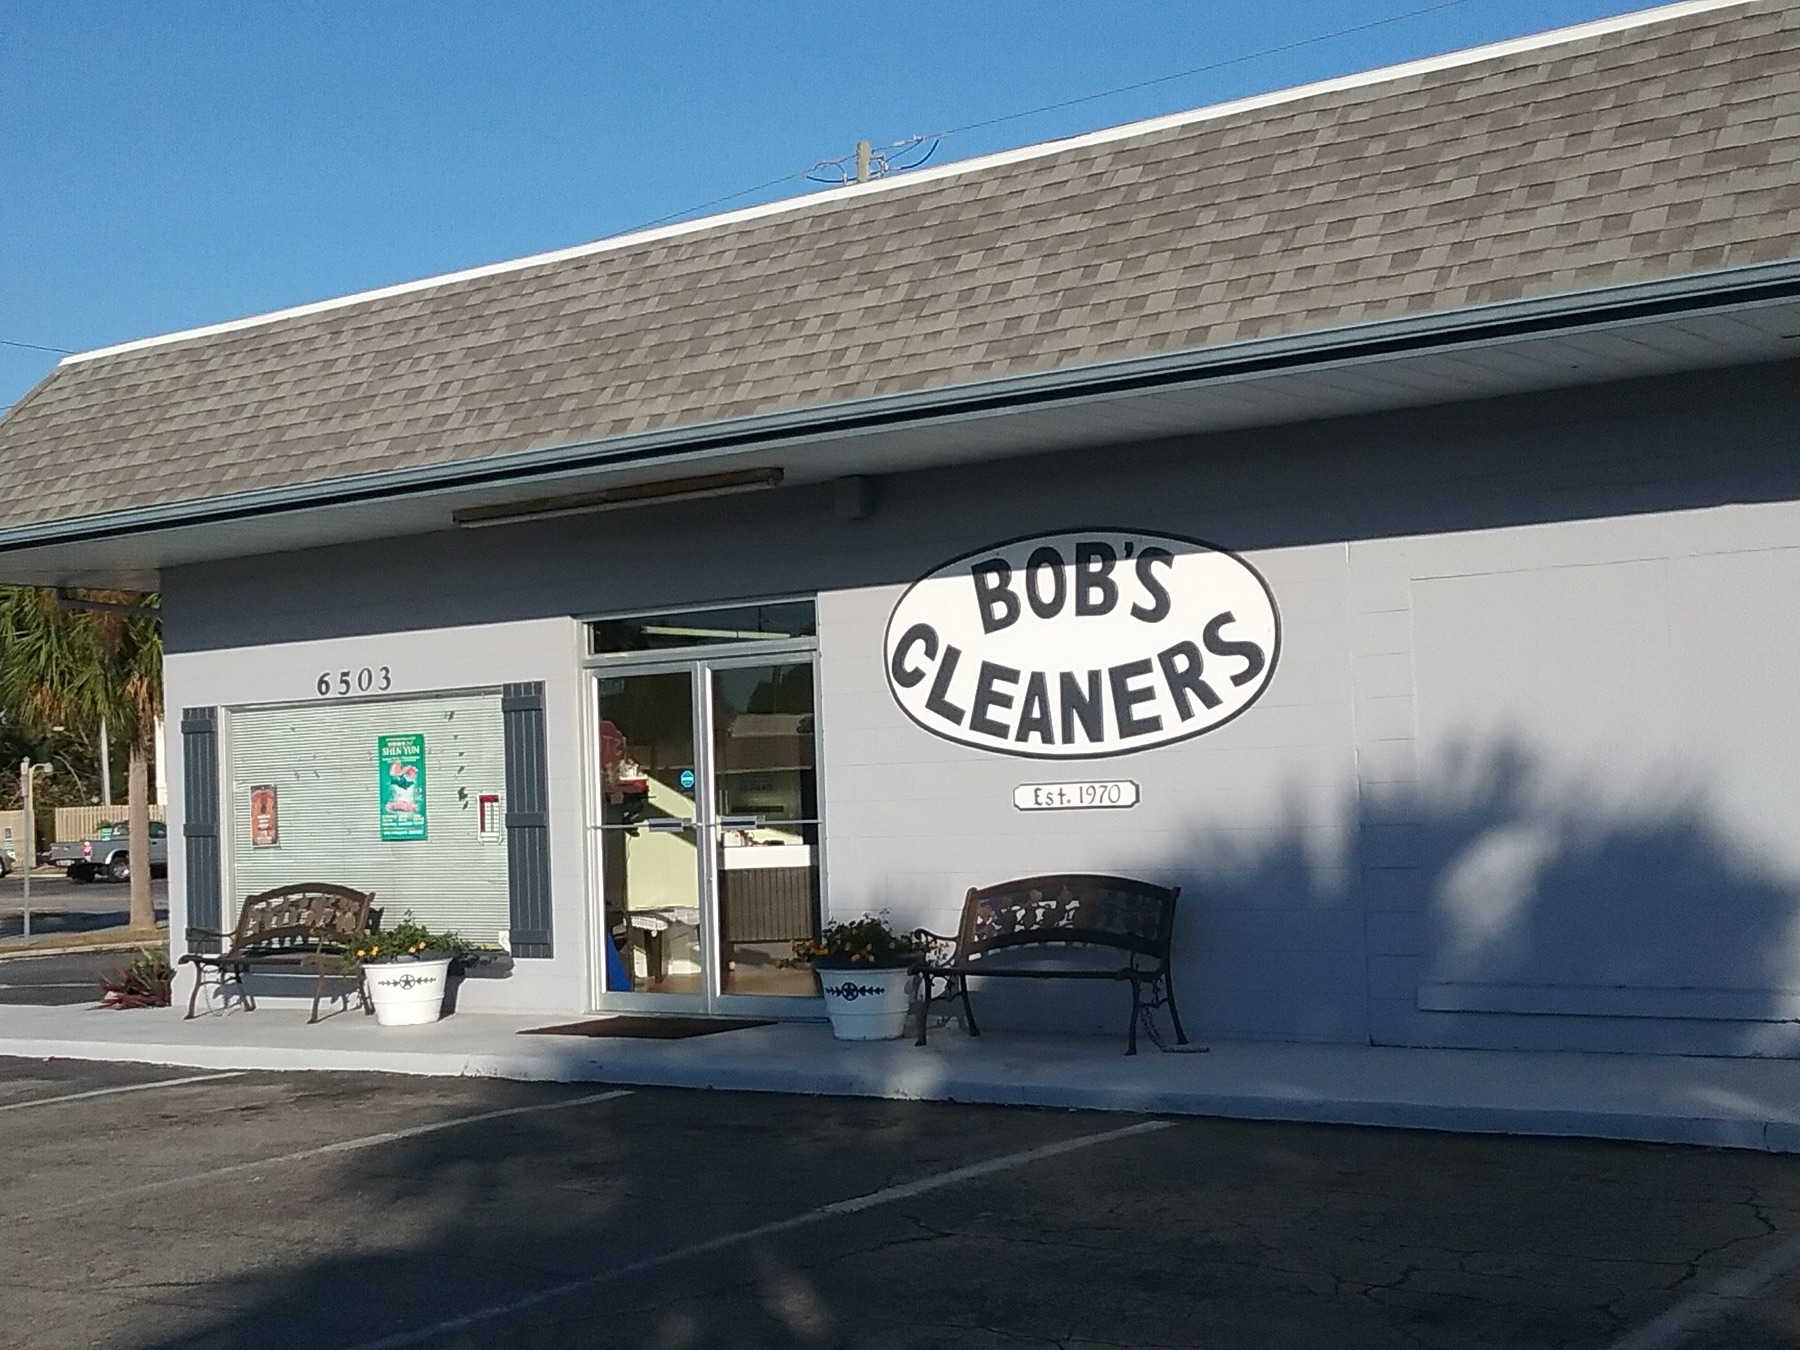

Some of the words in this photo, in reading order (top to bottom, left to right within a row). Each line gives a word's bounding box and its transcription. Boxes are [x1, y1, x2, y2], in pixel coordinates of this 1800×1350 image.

[971, 542, 1174, 634] BOB'S
[317, 666, 391, 696] 6503
[892, 611, 1266, 744] CLEANERS
[382, 747, 402, 756] SHEN
[403, 745, 420, 755] YUN
[1033, 787, 1072, 806] Est.
[1079, 784, 1121, 804] 1970
